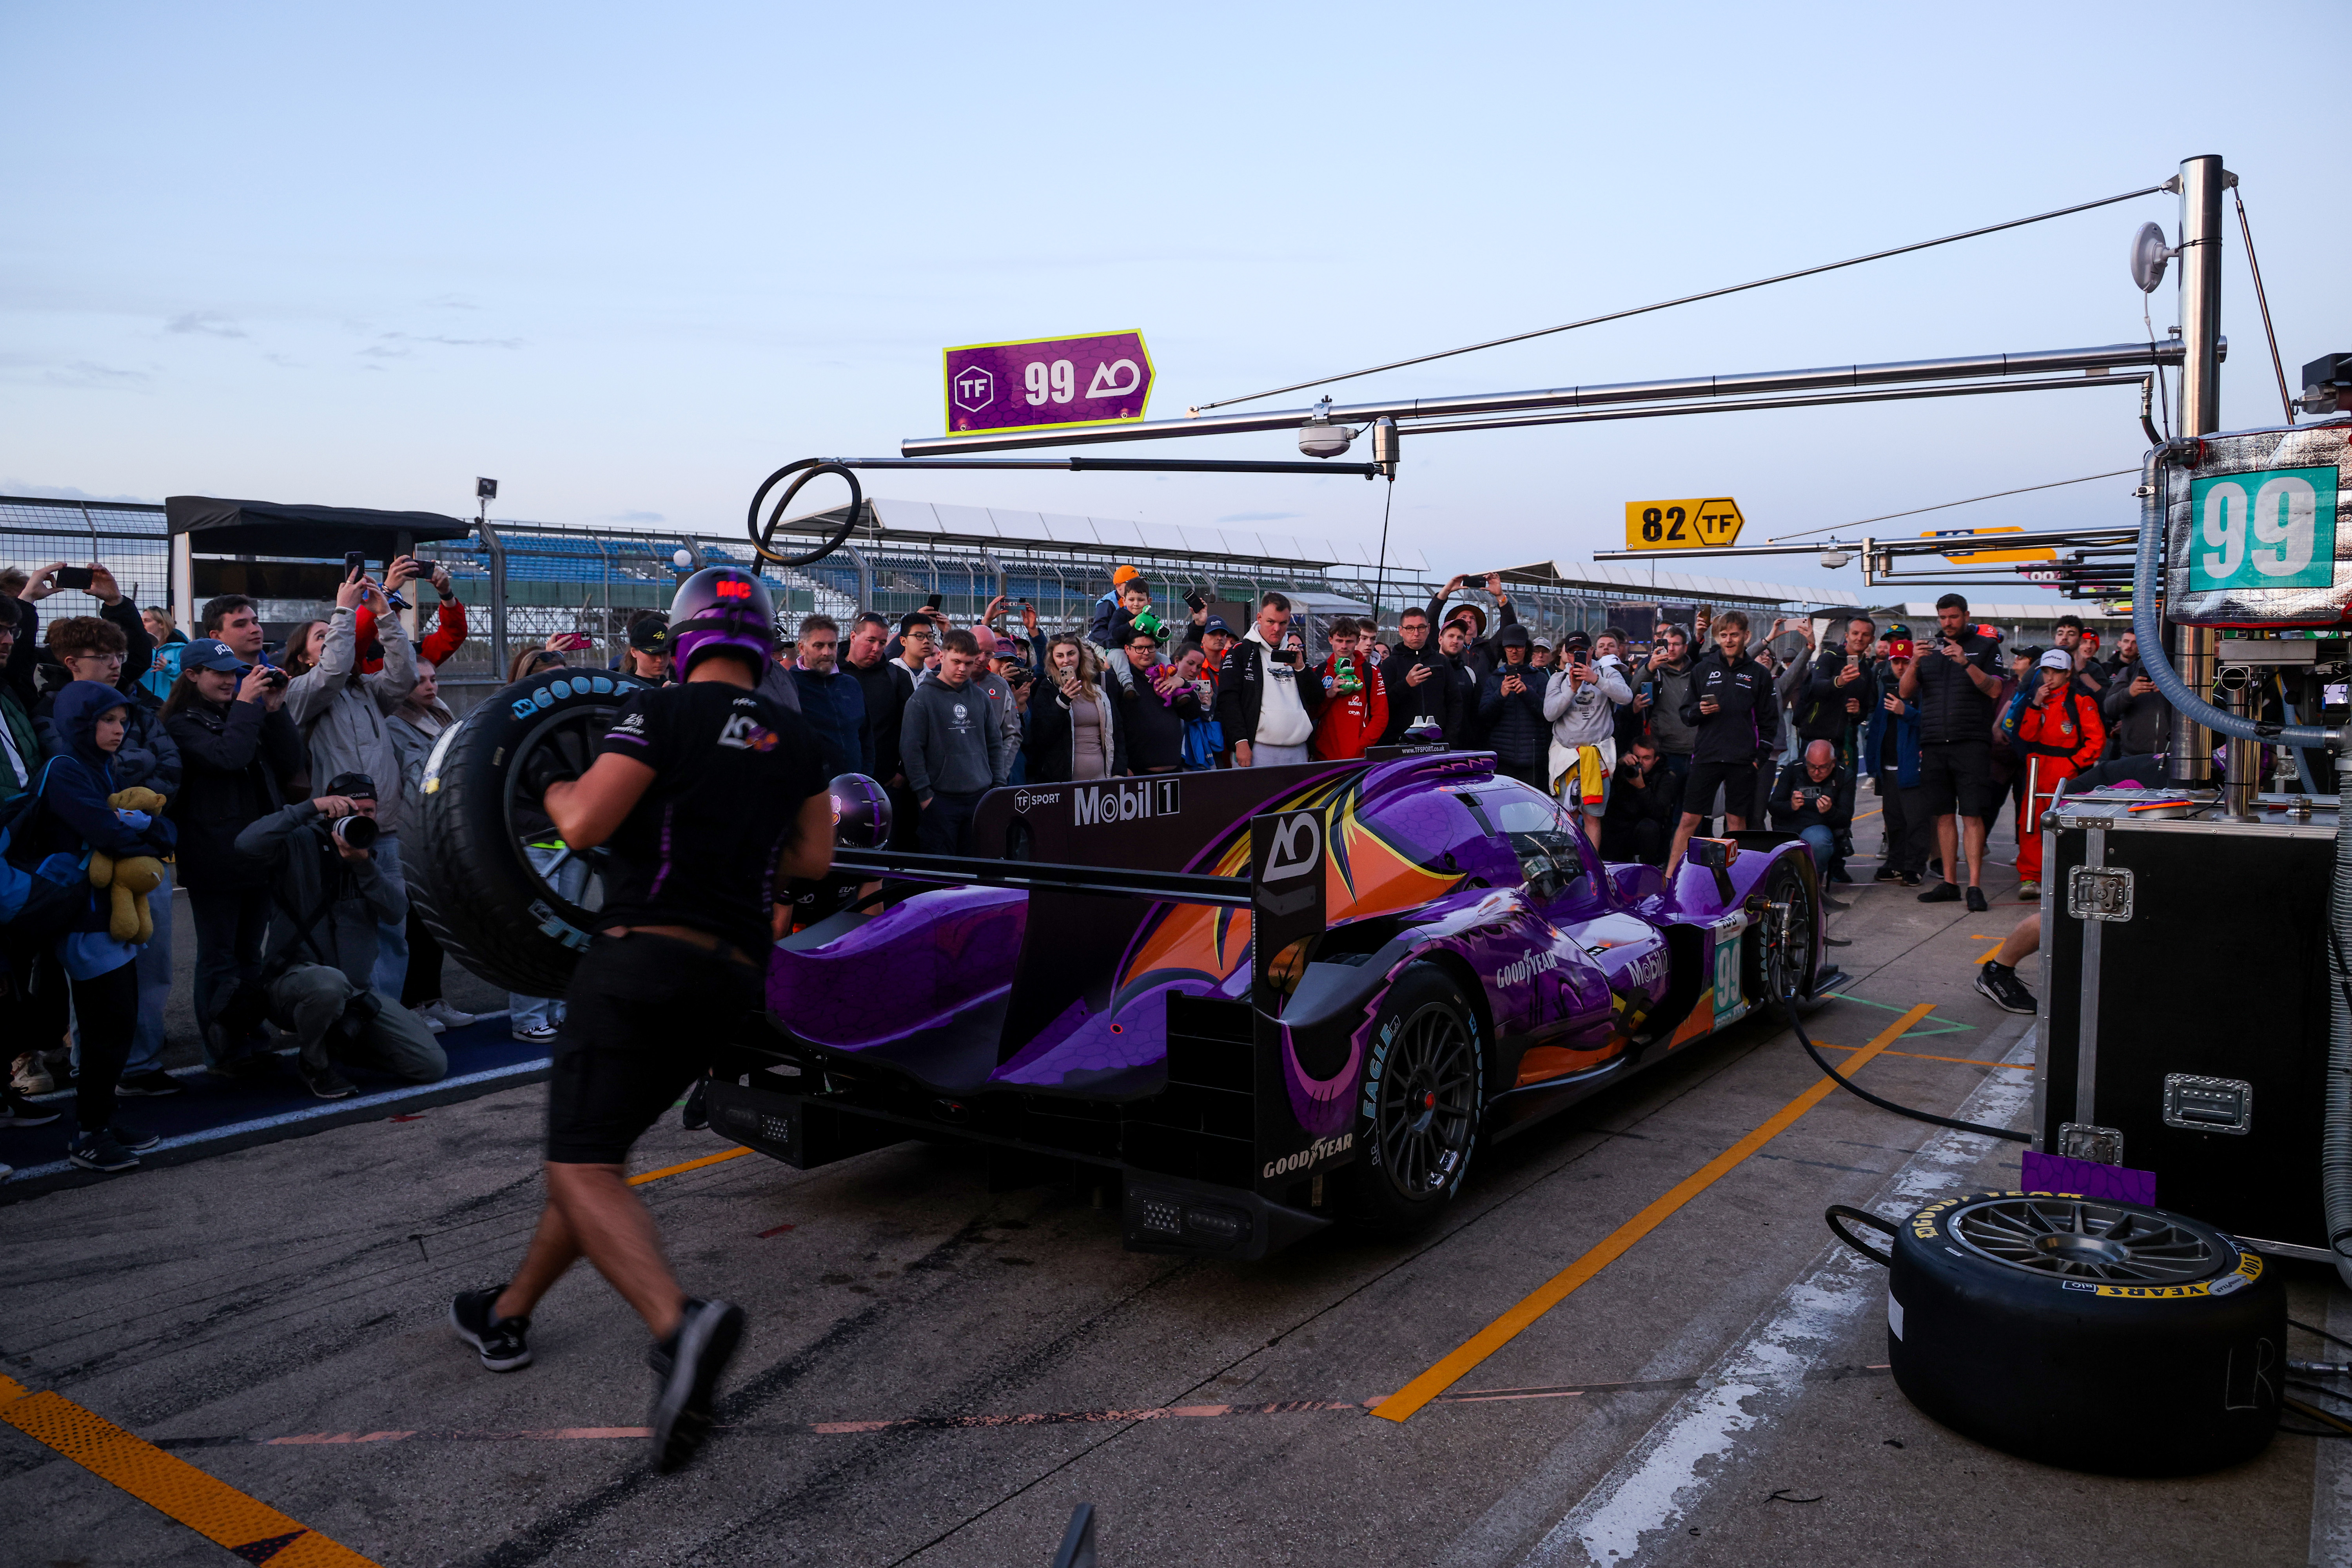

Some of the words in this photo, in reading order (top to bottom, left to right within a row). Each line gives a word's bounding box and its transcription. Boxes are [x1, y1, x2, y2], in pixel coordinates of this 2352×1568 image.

[959, 378, 987, 399] TF
[1025, 359, 1074, 405] 99
[1642, 506, 1686, 542] 82
[1702, 514, 1734, 534] TF
[2203, 476, 2316, 579] 99
[1323, 677, 1332, 688] hp
[1401, 745, 1445, 754] www.TFSPORT.co.uk
[1016, 796, 1028, 807] TF
[1031, 793, 1060, 806] SPORT
[1074, 781, 1151, 826] Mobil
[1496, 948, 1559, 989] GOODYEAR
[1624, 951, 1662, 987] Mobil
[1717, 942, 1741, 1008] 99
[1363, 1023, 1394, 1119] EAGLE
[1263, 1132, 1353, 1179] GOODYEAR
[2241, 1256, 2259, 1275] 100
[2109, 1286, 2204, 1297] YEARS
[2225, 1337, 2275, 1410] LR
